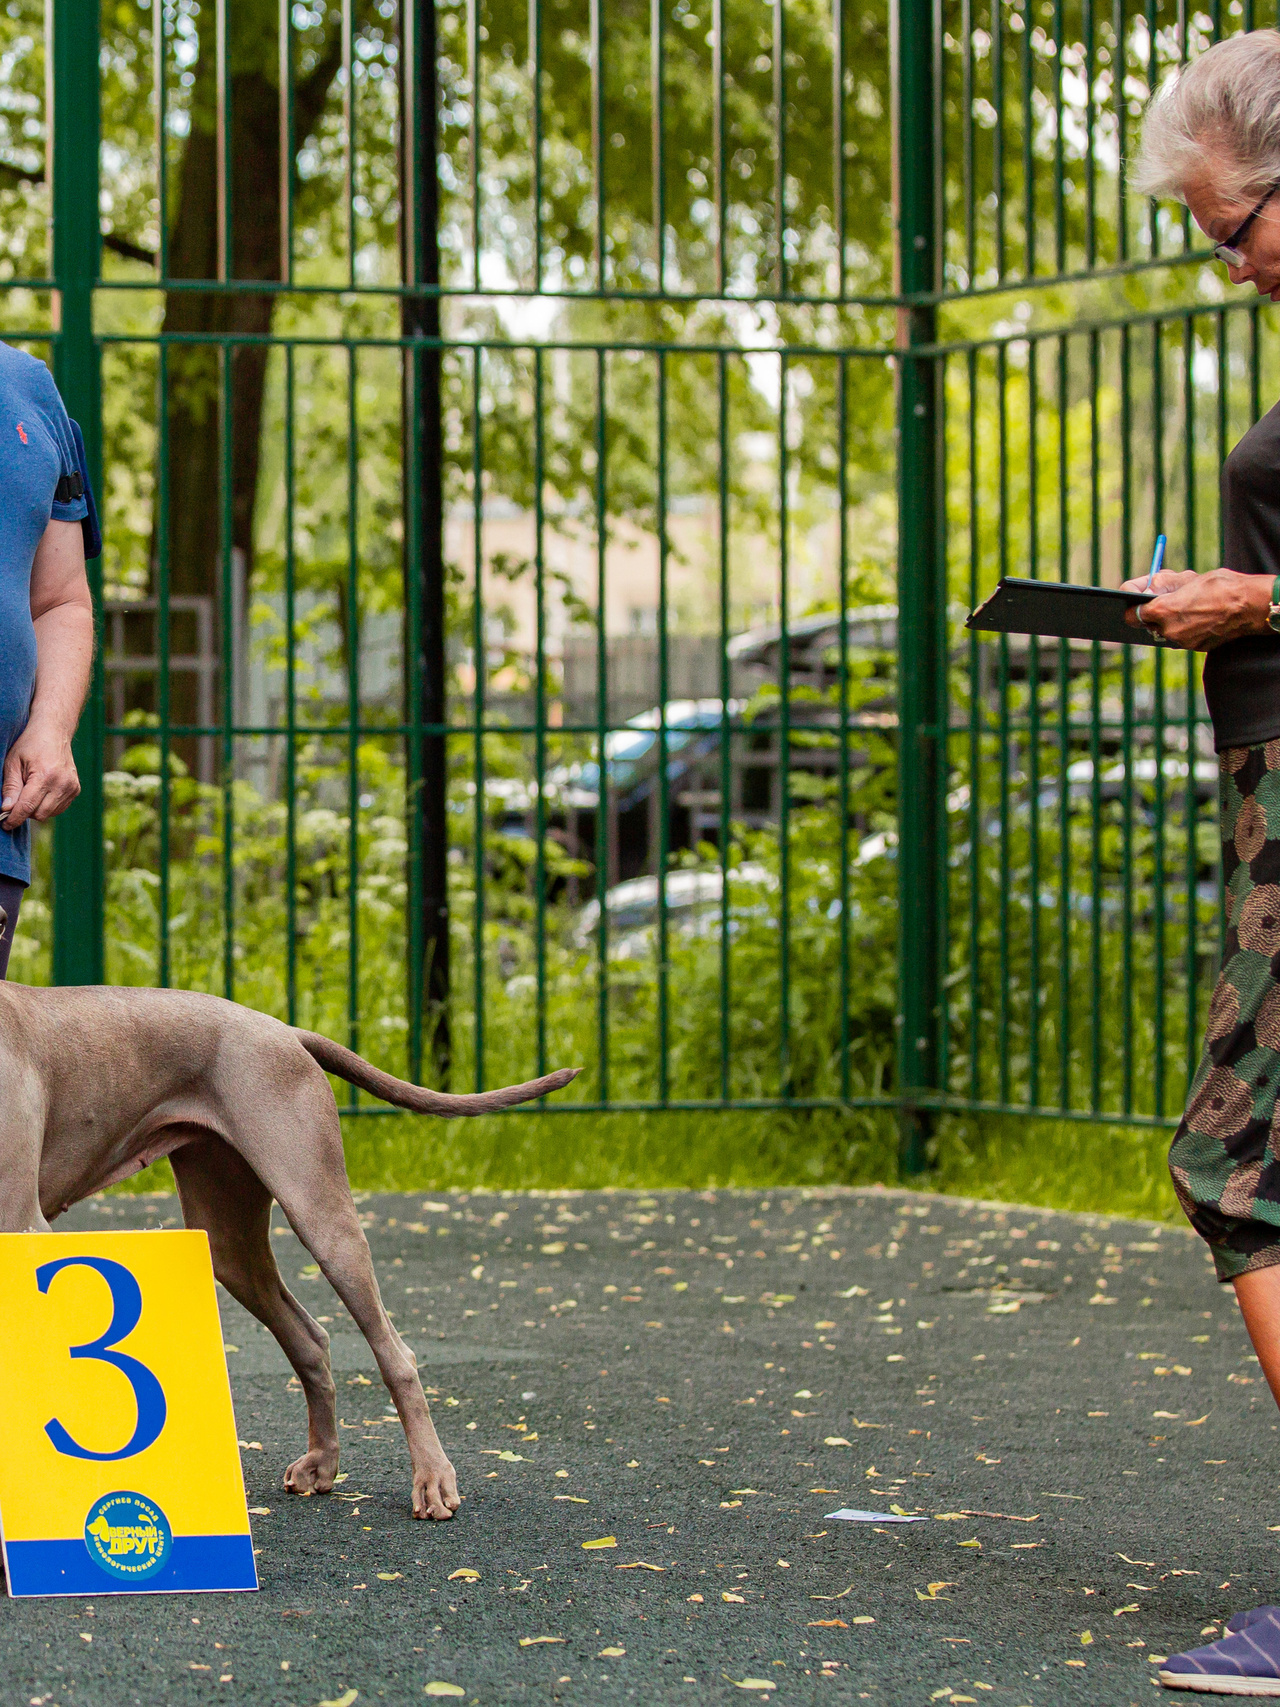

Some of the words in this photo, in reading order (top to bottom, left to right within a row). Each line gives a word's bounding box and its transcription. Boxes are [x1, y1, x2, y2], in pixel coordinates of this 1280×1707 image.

[35, 1255, 168, 1462] 3
[98, 1497, 132, 1515] СЕРГИЕВ
[134, 1499, 159, 1522] ПОСАД
[107, 1537, 158, 1555] ДРУГ
[154, 1530, 165, 1557] ЦЕНТР
